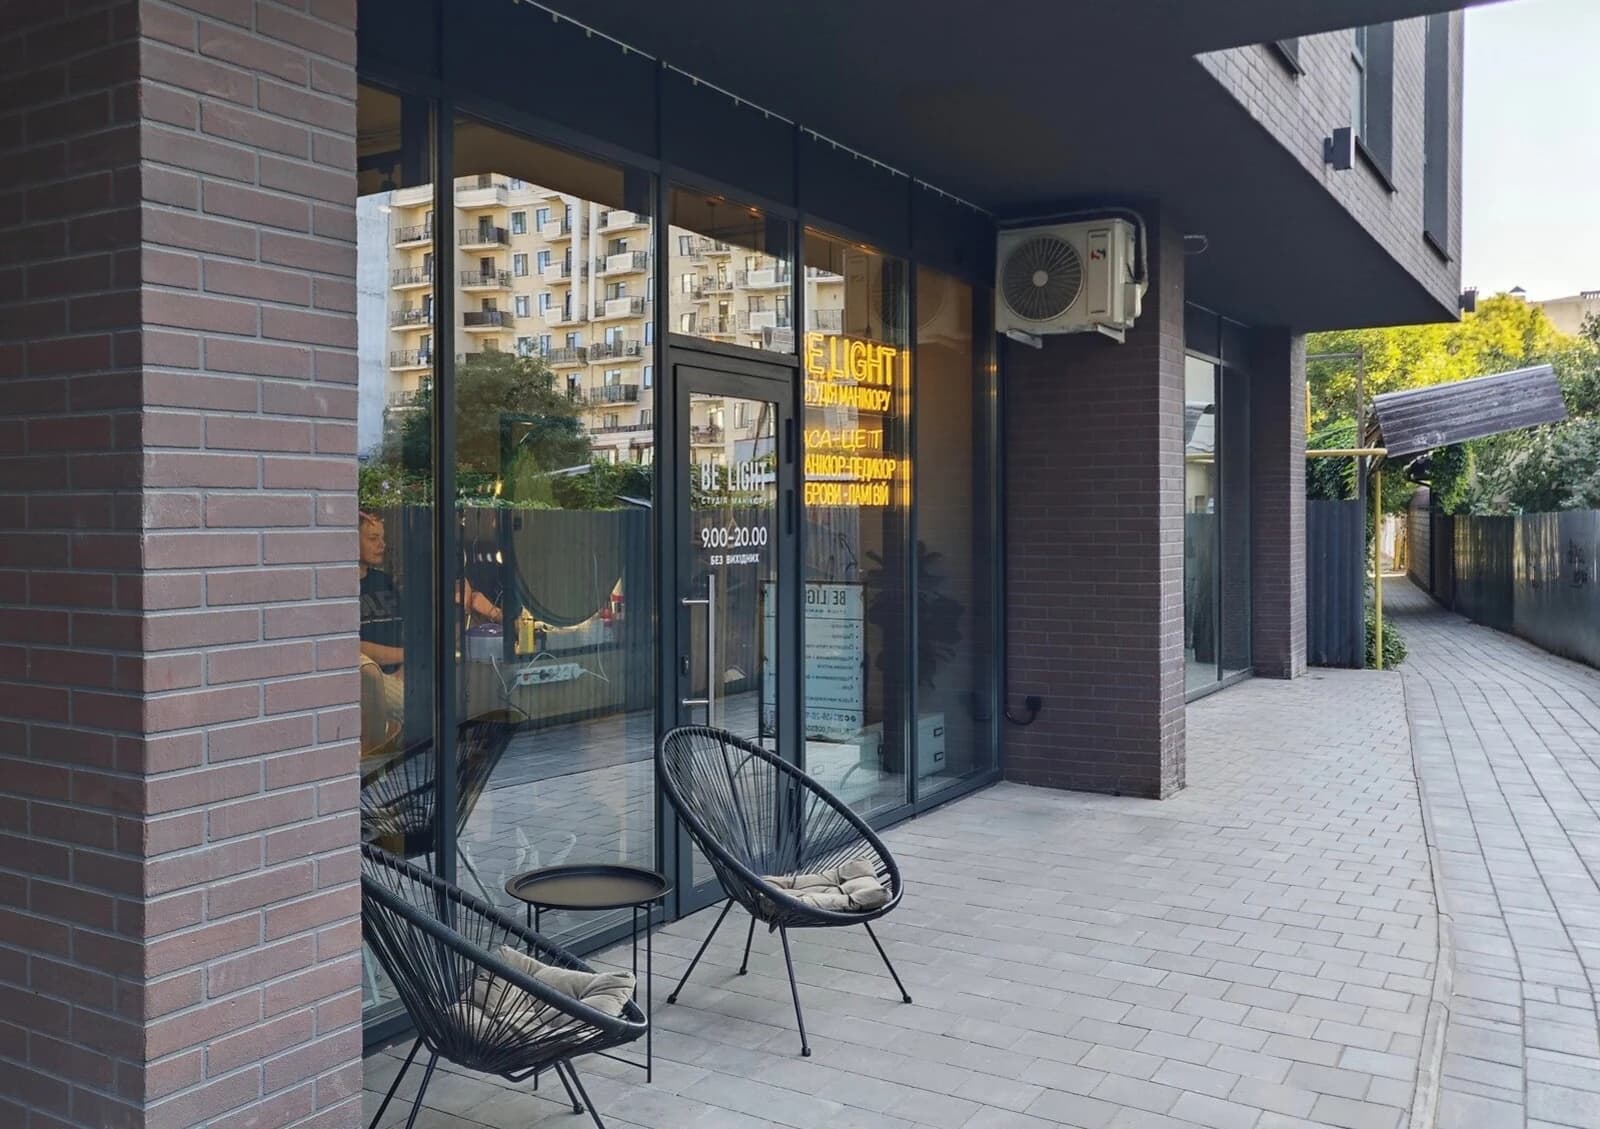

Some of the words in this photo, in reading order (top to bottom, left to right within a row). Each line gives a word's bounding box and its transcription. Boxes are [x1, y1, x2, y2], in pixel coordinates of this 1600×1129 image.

[829, 335, 897, 386] LIGHT
[701, 461, 720, 491] BE
[728, 461, 767, 491] LIGHT
[701, 496, 728, 506] СТУДІЯ
[805, 482, 842, 505] БРОВИ
[710, 554, 724, 566] БЕЗ
[726, 552, 760, 565] ВИХІДНИХ
